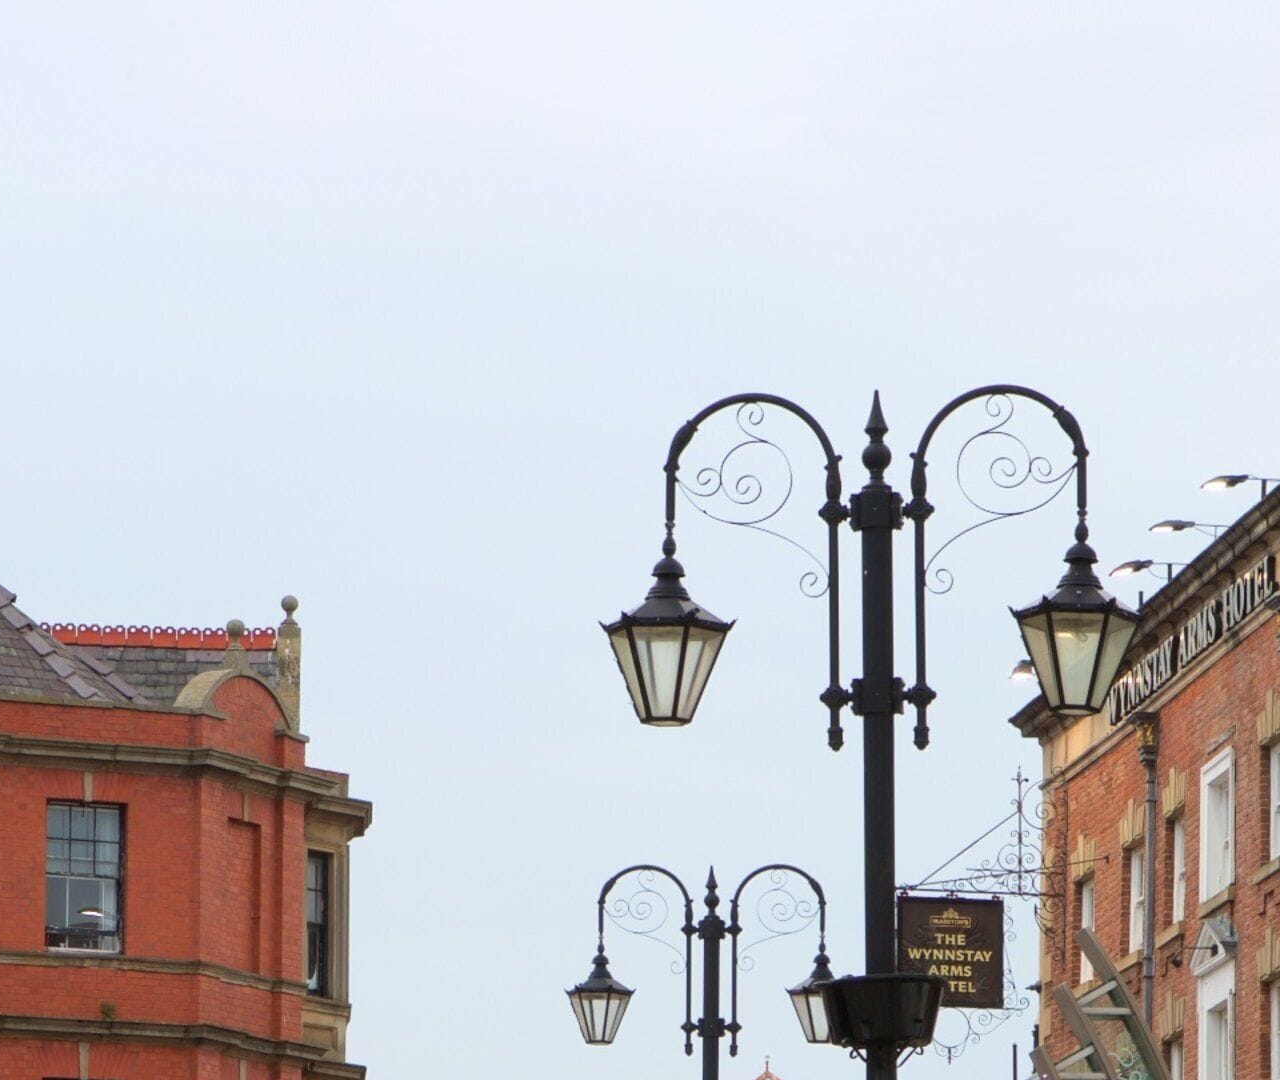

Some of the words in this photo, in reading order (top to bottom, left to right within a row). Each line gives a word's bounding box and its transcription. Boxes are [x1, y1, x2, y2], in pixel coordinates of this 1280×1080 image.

[1177, 600, 1217, 668] ARMS
[1222, 556, 1273, 632] HOTEL
[934, 933, 966, 945] THE
[907, 948, 993, 962] WYNNSTAY
[928, 964, 972, 977] ARMS
[948, 980, 976, 993] TEL
